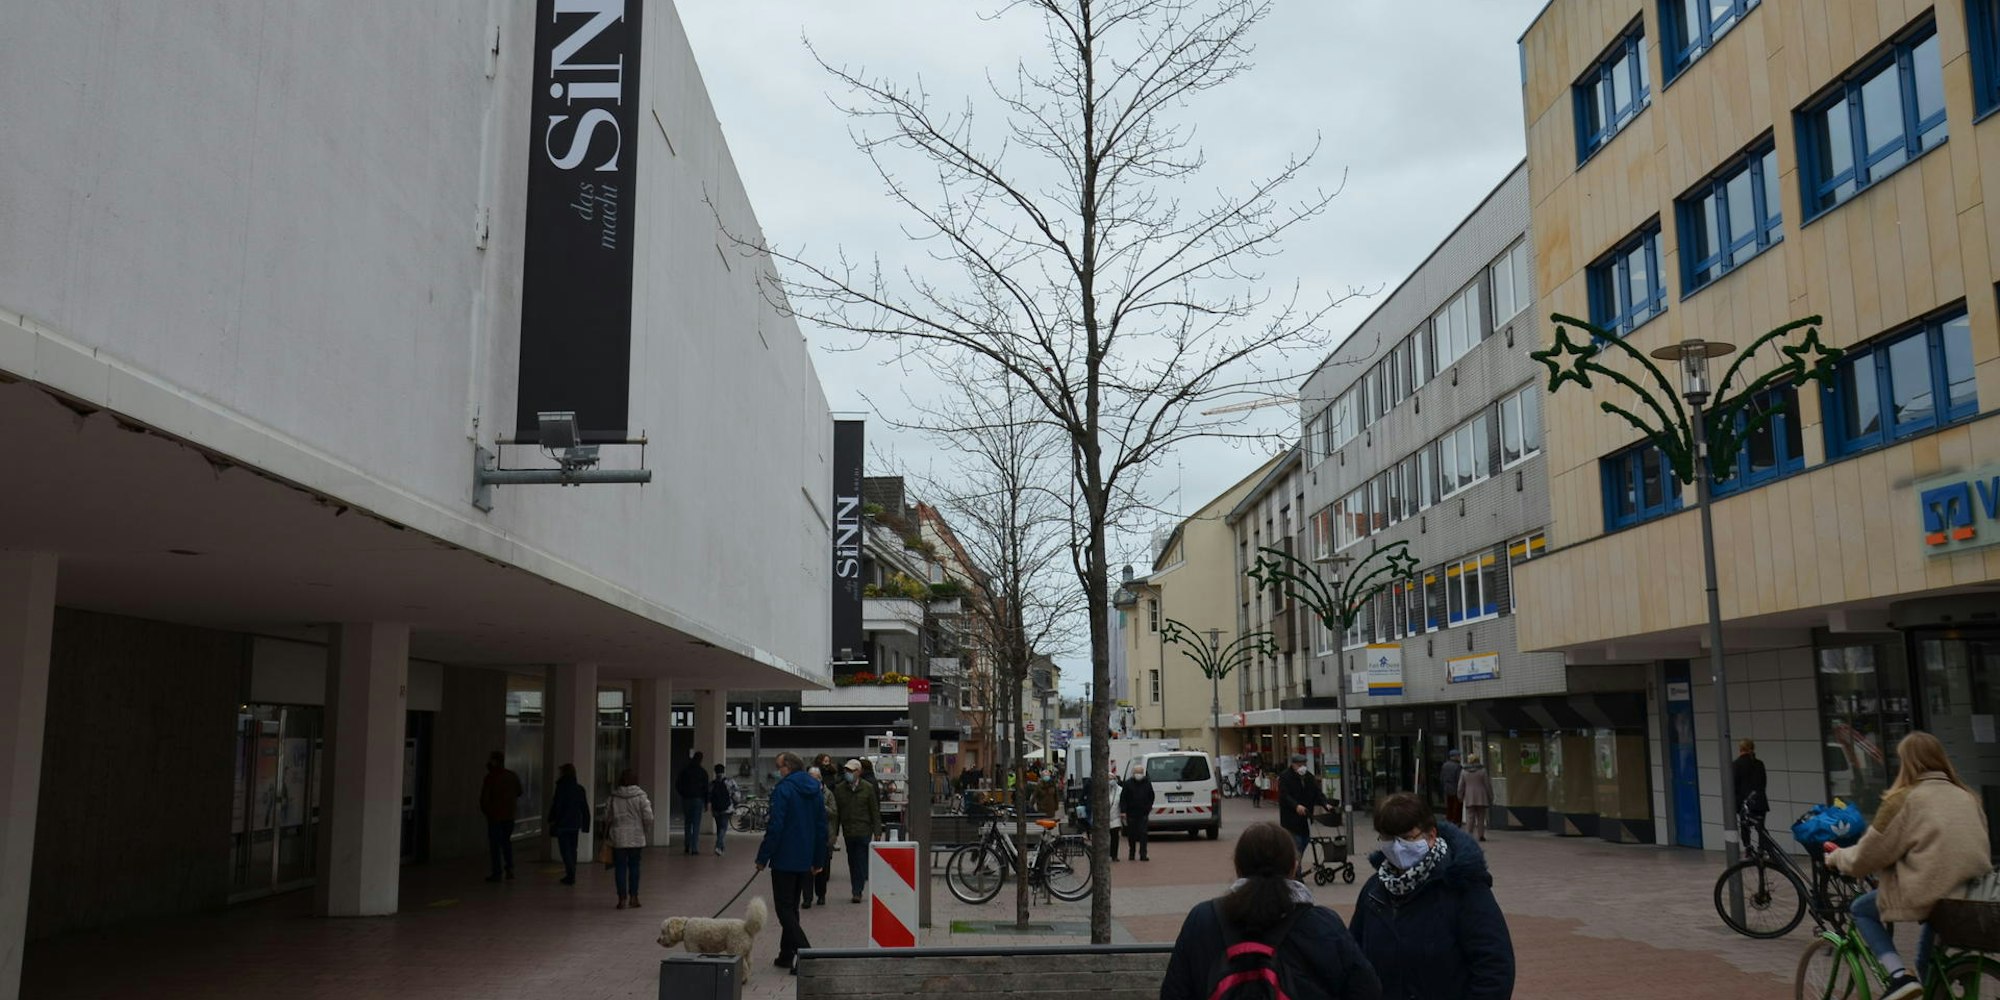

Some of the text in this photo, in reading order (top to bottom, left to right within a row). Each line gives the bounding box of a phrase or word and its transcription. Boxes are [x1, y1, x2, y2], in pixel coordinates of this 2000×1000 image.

[570, 182, 595, 221] das
[595, 184, 618, 250] macht
[836, 494, 859, 578] SiNN
